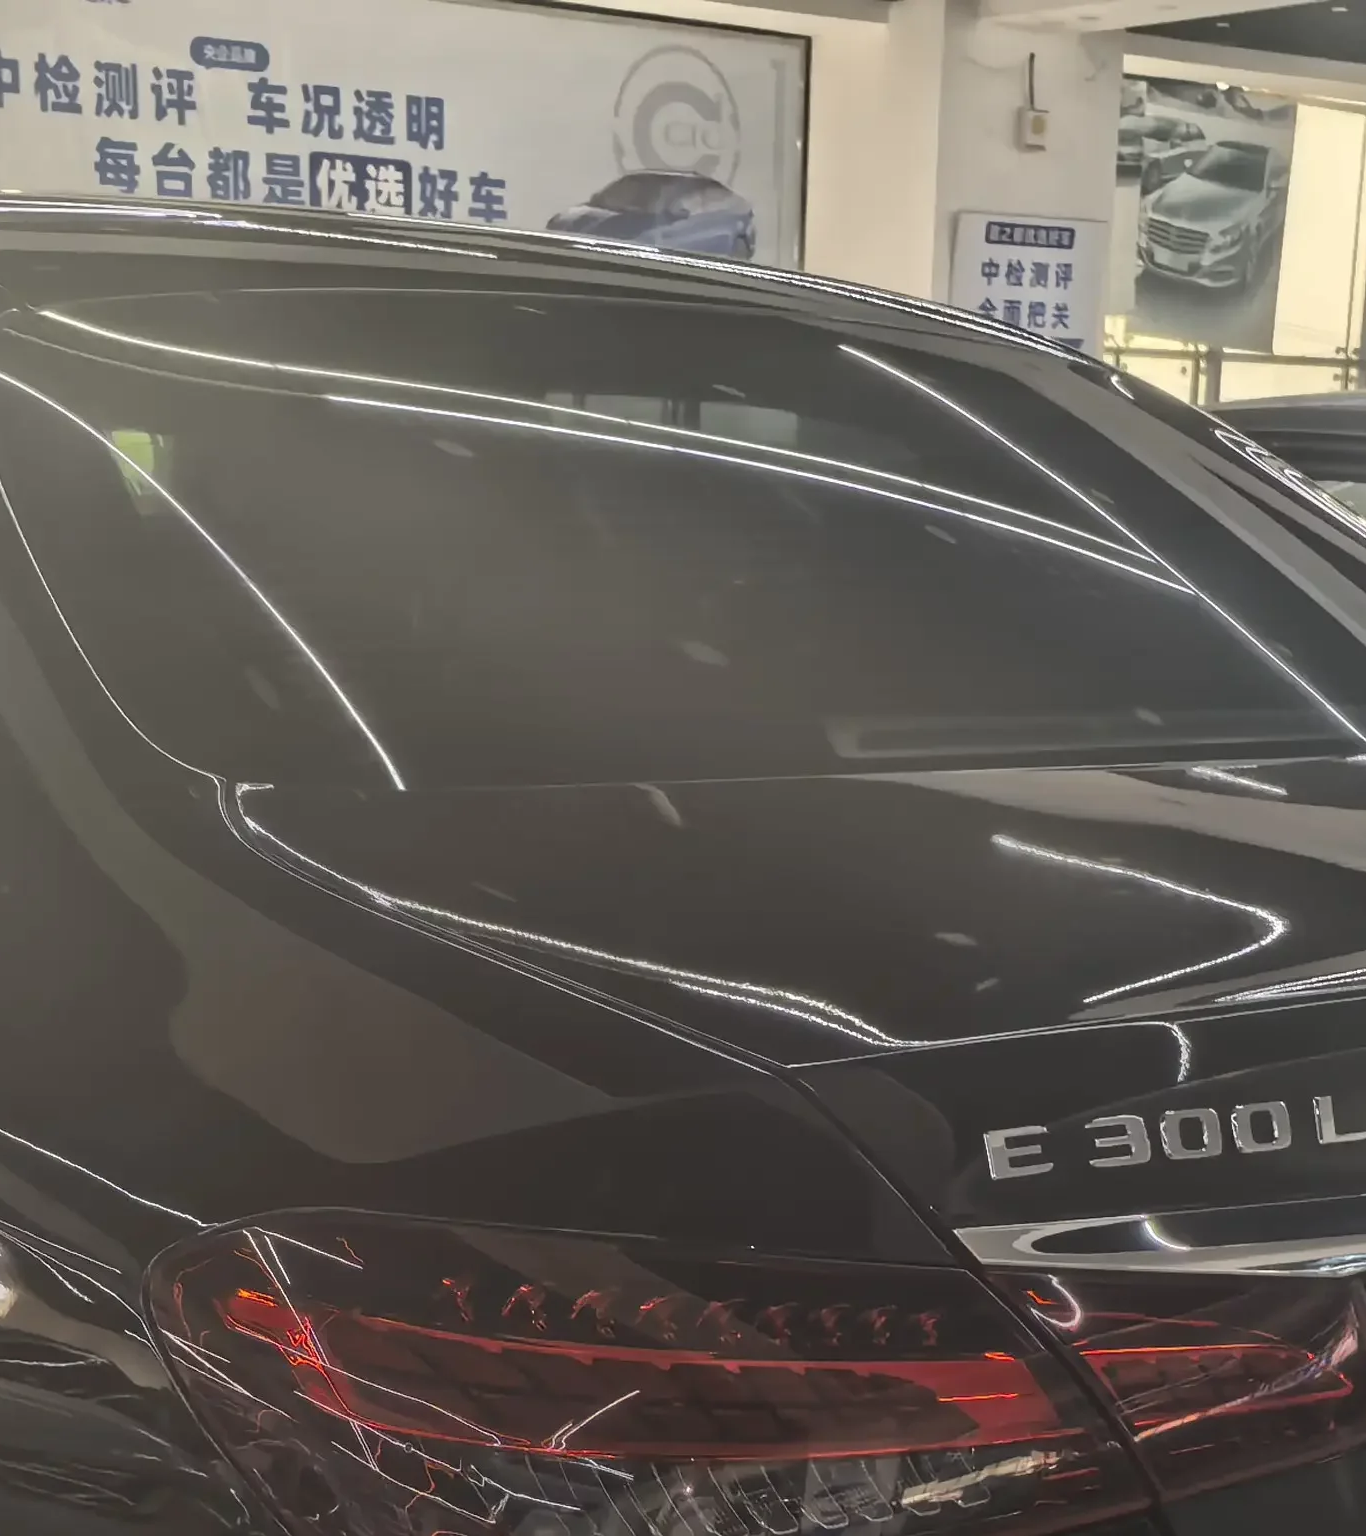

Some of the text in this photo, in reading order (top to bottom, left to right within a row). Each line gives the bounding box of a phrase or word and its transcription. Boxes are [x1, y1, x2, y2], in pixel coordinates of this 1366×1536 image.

[246, 76, 444, 151] 车况透明
[93, 136, 508, 223] 每台都是优选好车
[981, 258, 1073, 290] 中检测评
[983, 1125, 1054, 1180] E
[1084, 1100, 1292, 1168] 300
